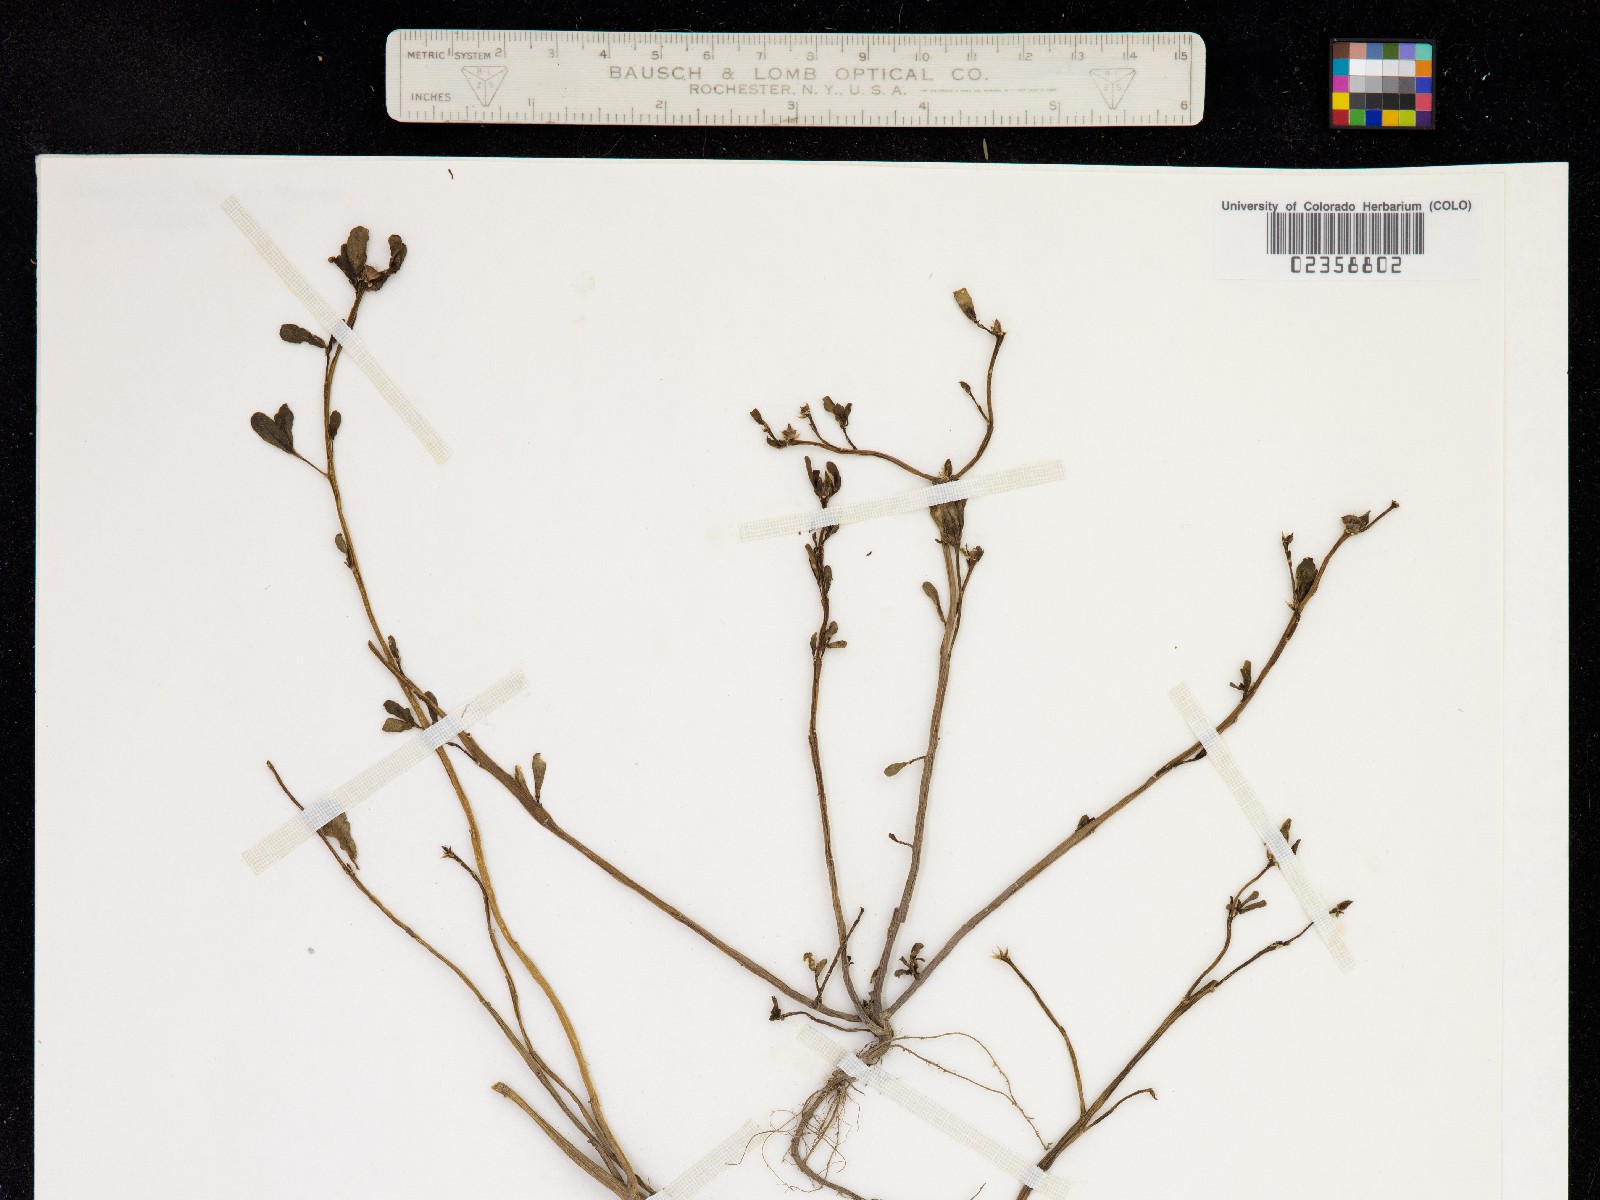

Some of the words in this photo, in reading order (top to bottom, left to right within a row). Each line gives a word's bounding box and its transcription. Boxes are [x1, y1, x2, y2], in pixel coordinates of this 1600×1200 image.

[407, 51, 445, 60] METRIC
[454, 52, 491, 60] SYSTEM
[494, 48, 503, 57] 2
[548, 49, 555, 58] 3
[599, 50, 607, 59] 4
[651, 51, 659, 60] 5
[703, 51, 711, 60] 6
[756, 52, 763, 60] 7
[806, 52, 815, 61] 8
[859, 52, 867, 61] 9
[914, 52, 930, 61] 10
[1018, 52, 1033, 61] 12
[1071, 52, 1085, 61] 13
[1122, 52, 1138, 61] 14
[1174, 51, 1188, 61] 15
[609, 66, 702, 80] BAUSCH
[721, 67, 734, 80] &
[754, 67, 817, 81] LOMB
[835, 67, 934, 81] OPTICAL
[951, 67, 989, 81] CO.
[689, 83, 795, 97] ROCHESTER,
[410, 92, 451, 102] INCHES
[655, 100, 663, 109] 2
[787, 101, 795, 110] 3
[918, 101, 927, 110] 4
[1049, 101, 1057, 110] 5
[1180, 100, 1188, 110] 6
[1222, 201, 1278, 213] University
[1286, 201, 1296, 211] of
[1304, 201, 1355, 211] Colorado
[1363, 201, 1421, 211] Herbarium
[1430, 200, 1471, 212] (COLO)
